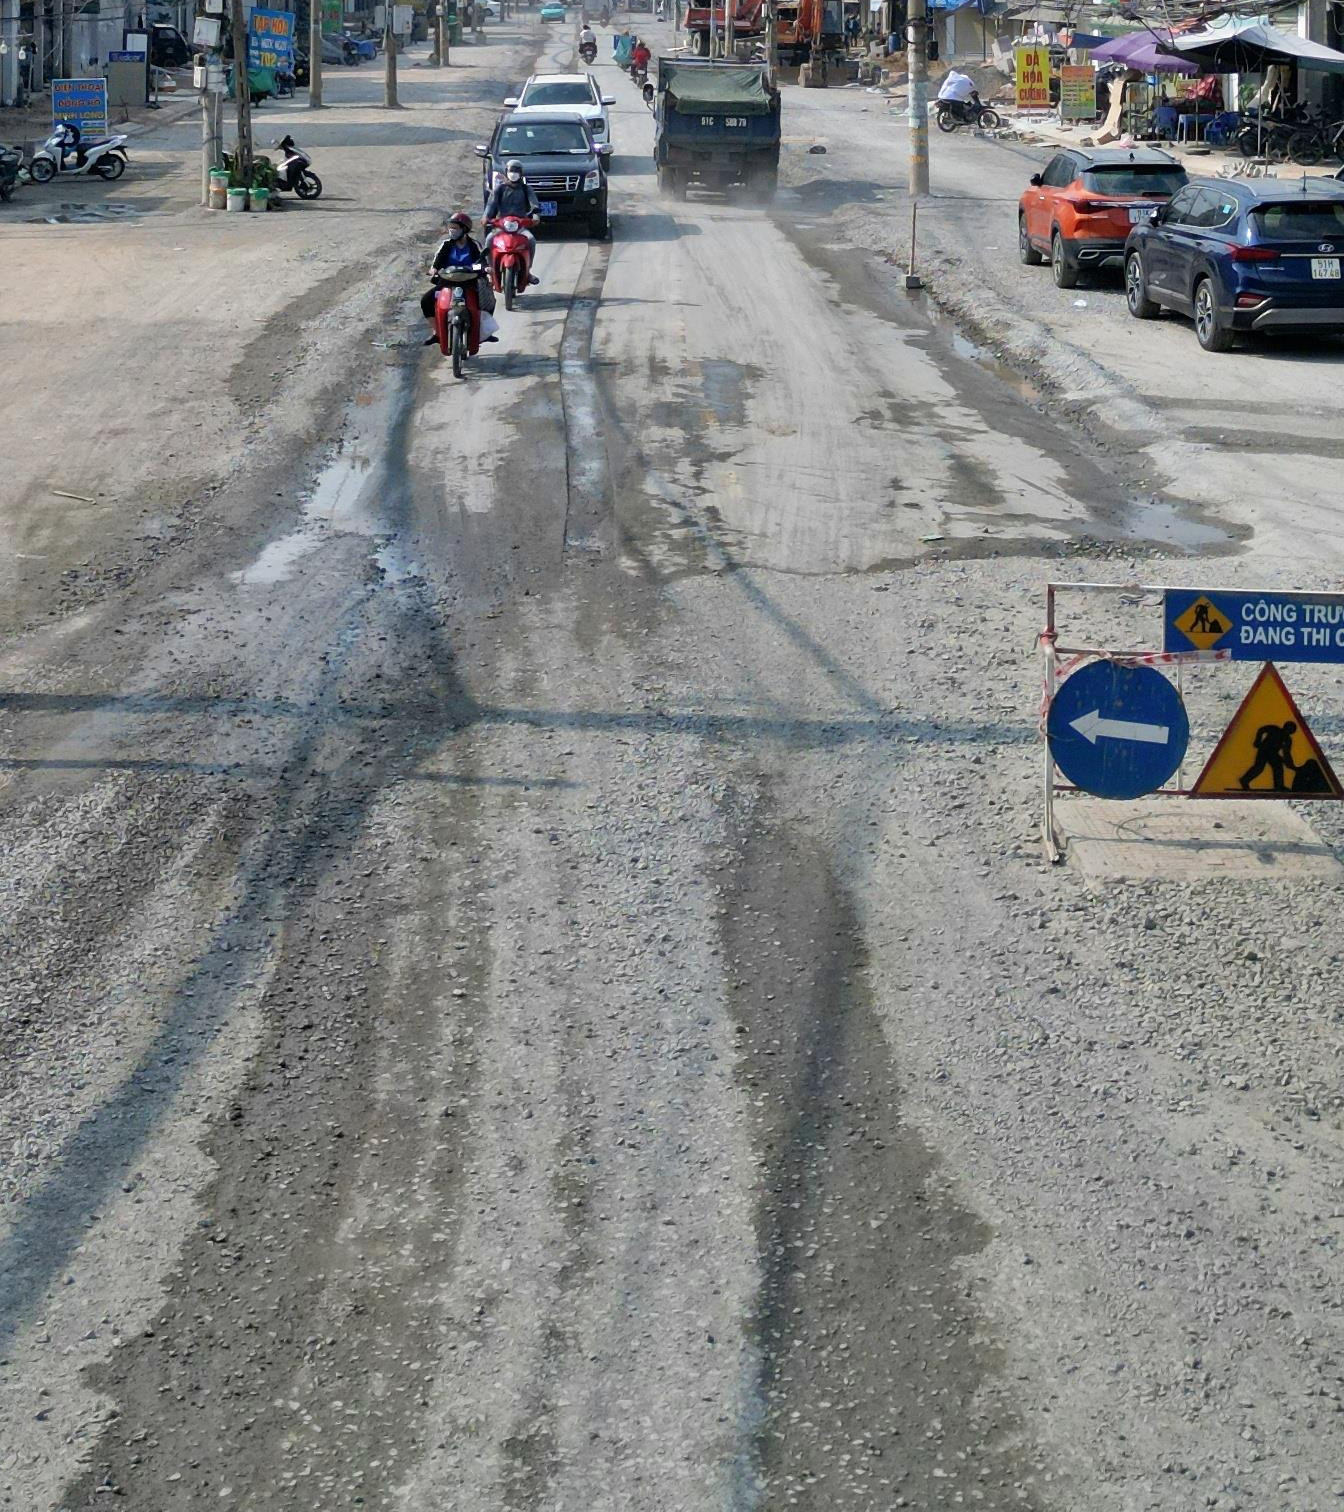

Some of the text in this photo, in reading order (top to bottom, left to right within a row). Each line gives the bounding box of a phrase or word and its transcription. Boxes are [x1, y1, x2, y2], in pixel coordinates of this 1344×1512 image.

[1317, 259, 1334, 269] 51H
[1241, 599, 1297, 622] CÔNG
[1240, 626, 1296, 645] ĐANG
[1300, 627, 1330, 646] THI
